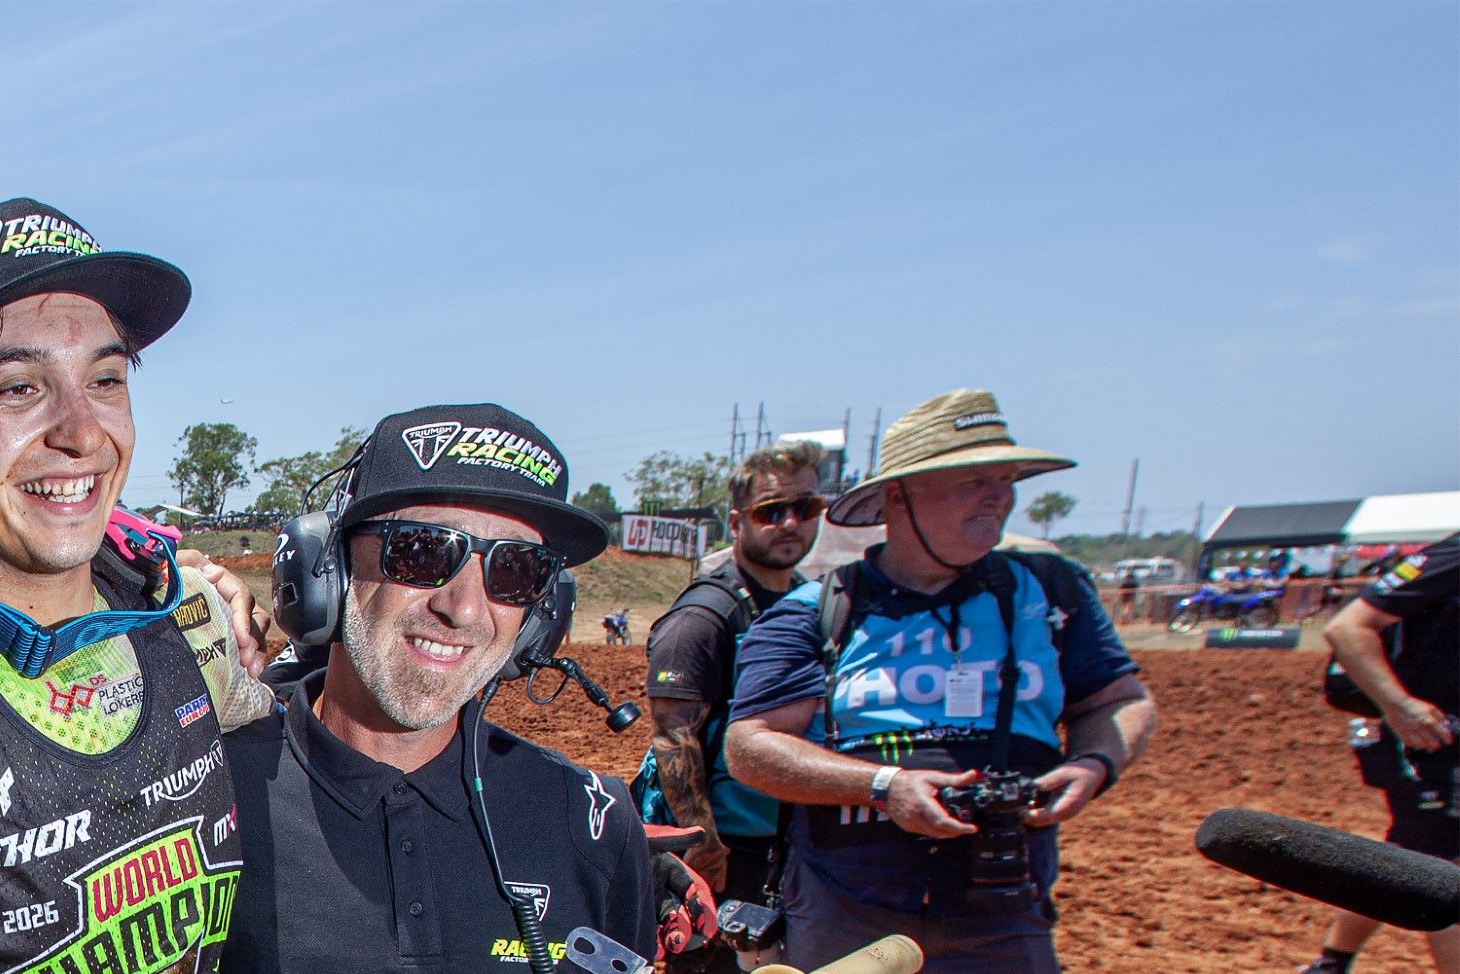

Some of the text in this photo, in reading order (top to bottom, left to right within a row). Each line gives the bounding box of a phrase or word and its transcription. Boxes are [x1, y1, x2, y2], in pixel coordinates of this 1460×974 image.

[1, 230, 100, 256] RACIN
[15, 245, 74, 258] FACTORY
[409, 426, 453, 439] TRIUMPH
[447, 442, 557, 487] RACING
[457, 427, 563, 477] TRIUMPH
[457, 456, 547, 488] FACTORY TEAM
[885, 627, 973, 657] 110
[833, 660, 1044, 709] HOTO
[140, 751, 216, 808] TRIUMPH
[91, 838, 199, 923] WORLD
[2, 900, 60, 935] 2026
